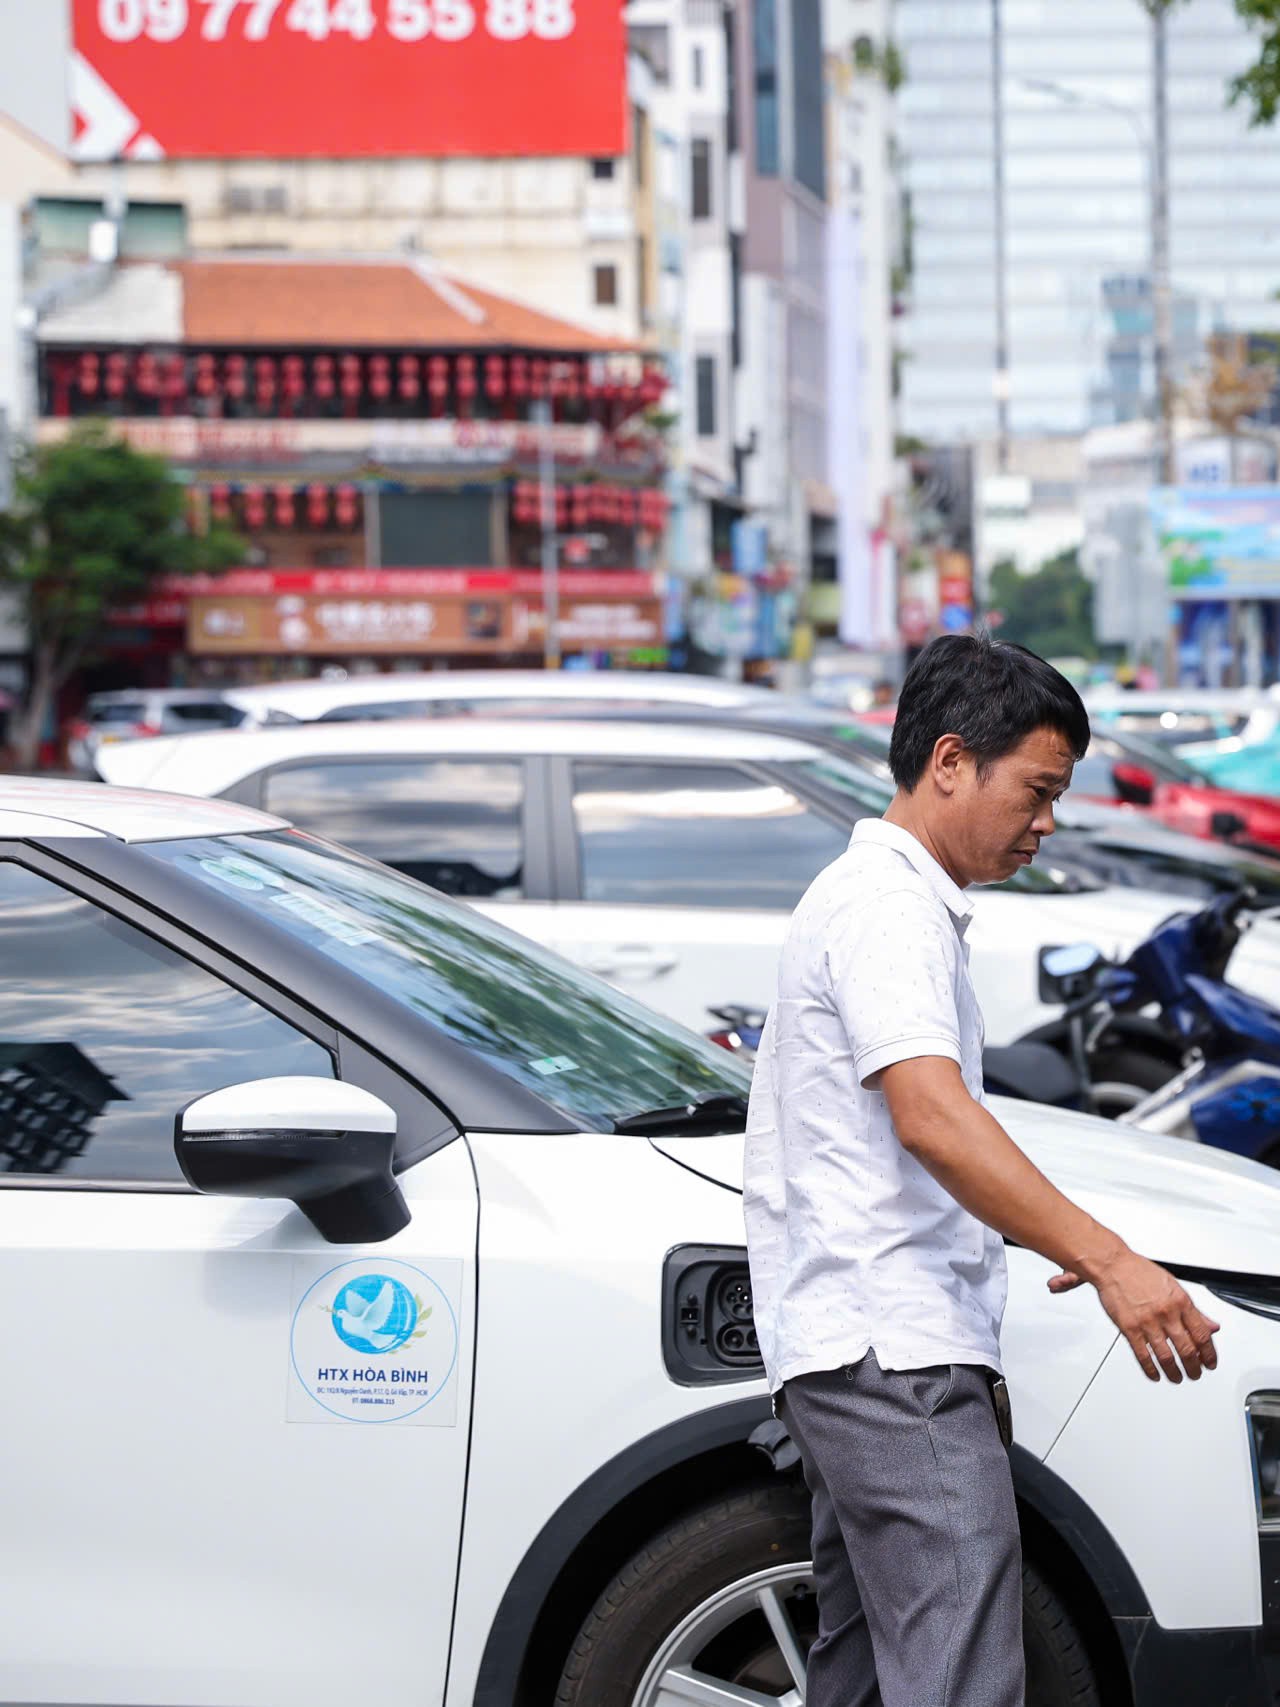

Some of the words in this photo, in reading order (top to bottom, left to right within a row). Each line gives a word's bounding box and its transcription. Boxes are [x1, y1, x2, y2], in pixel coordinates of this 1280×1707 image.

[318, 1368, 349, 1381] HTX
[353, 1366, 386, 1382] HÒA
[391, 1367, 428, 1383] BÌNH
